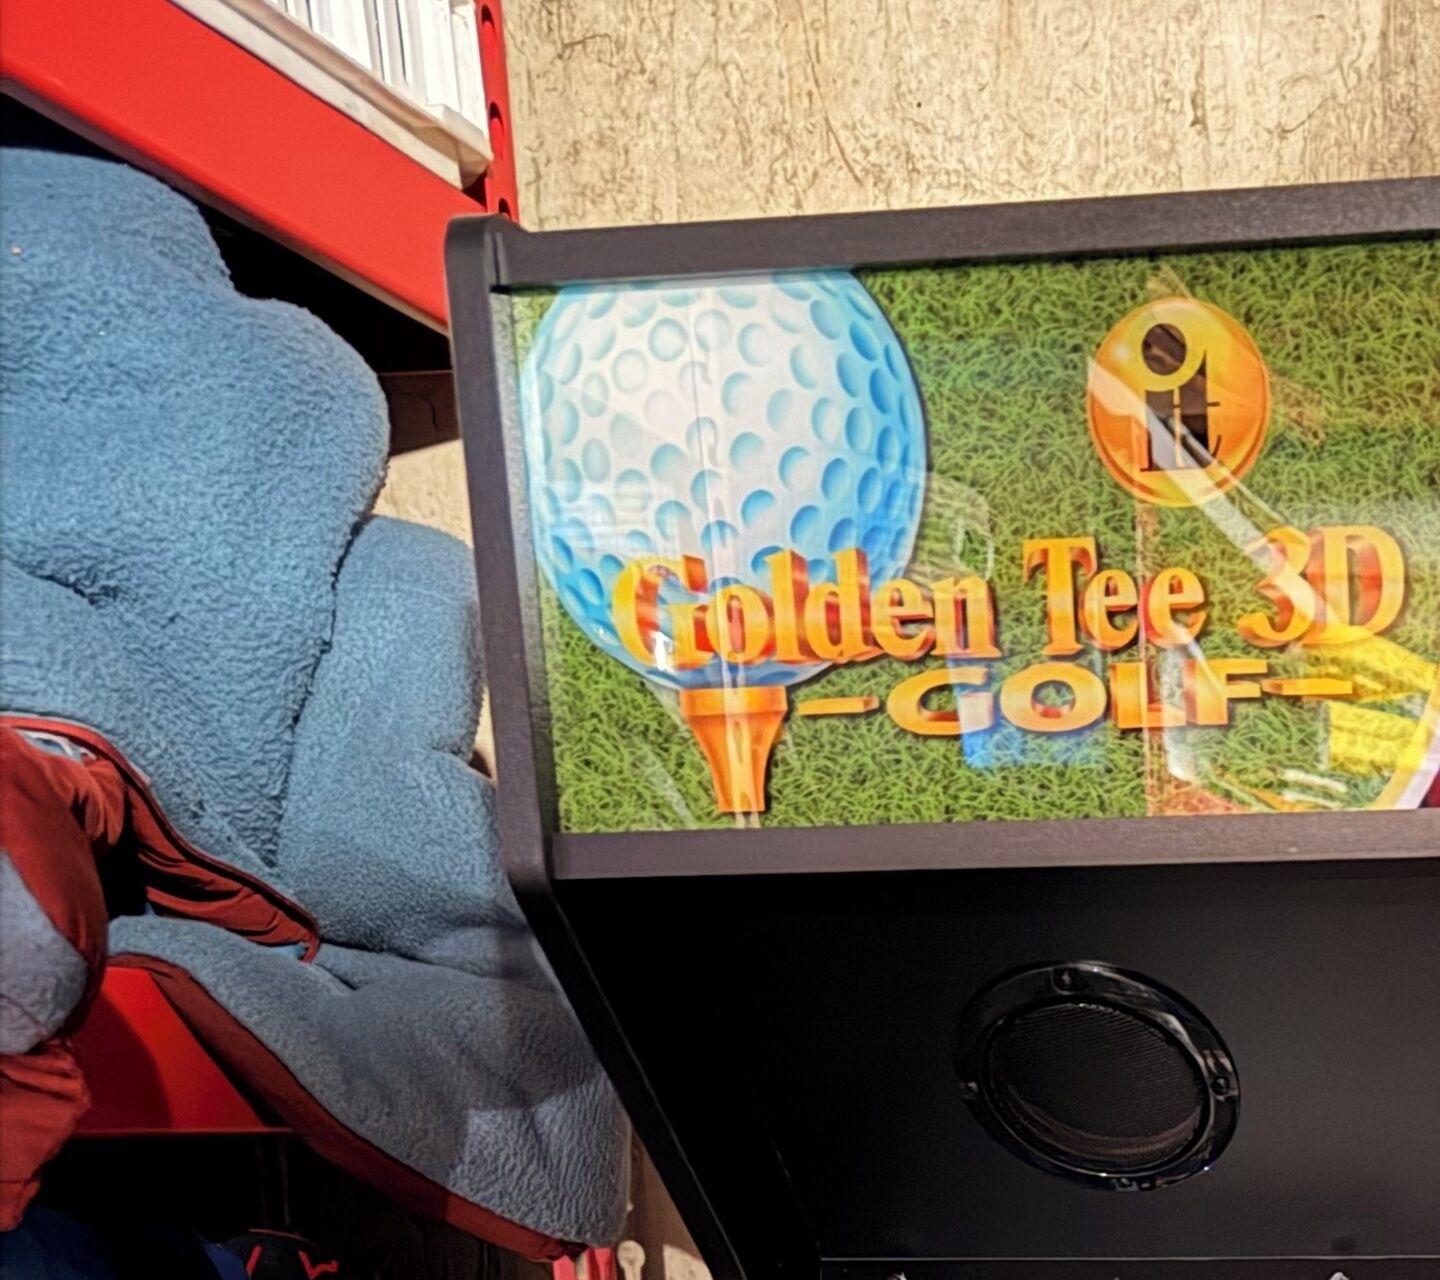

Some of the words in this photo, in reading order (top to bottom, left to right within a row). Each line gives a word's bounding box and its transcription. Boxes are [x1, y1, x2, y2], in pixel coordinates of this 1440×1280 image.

[611, 545, 998, 673] Golden
[1022, 536, 1206, 657] Tee
[1237, 524, 1406, 649] 3D
